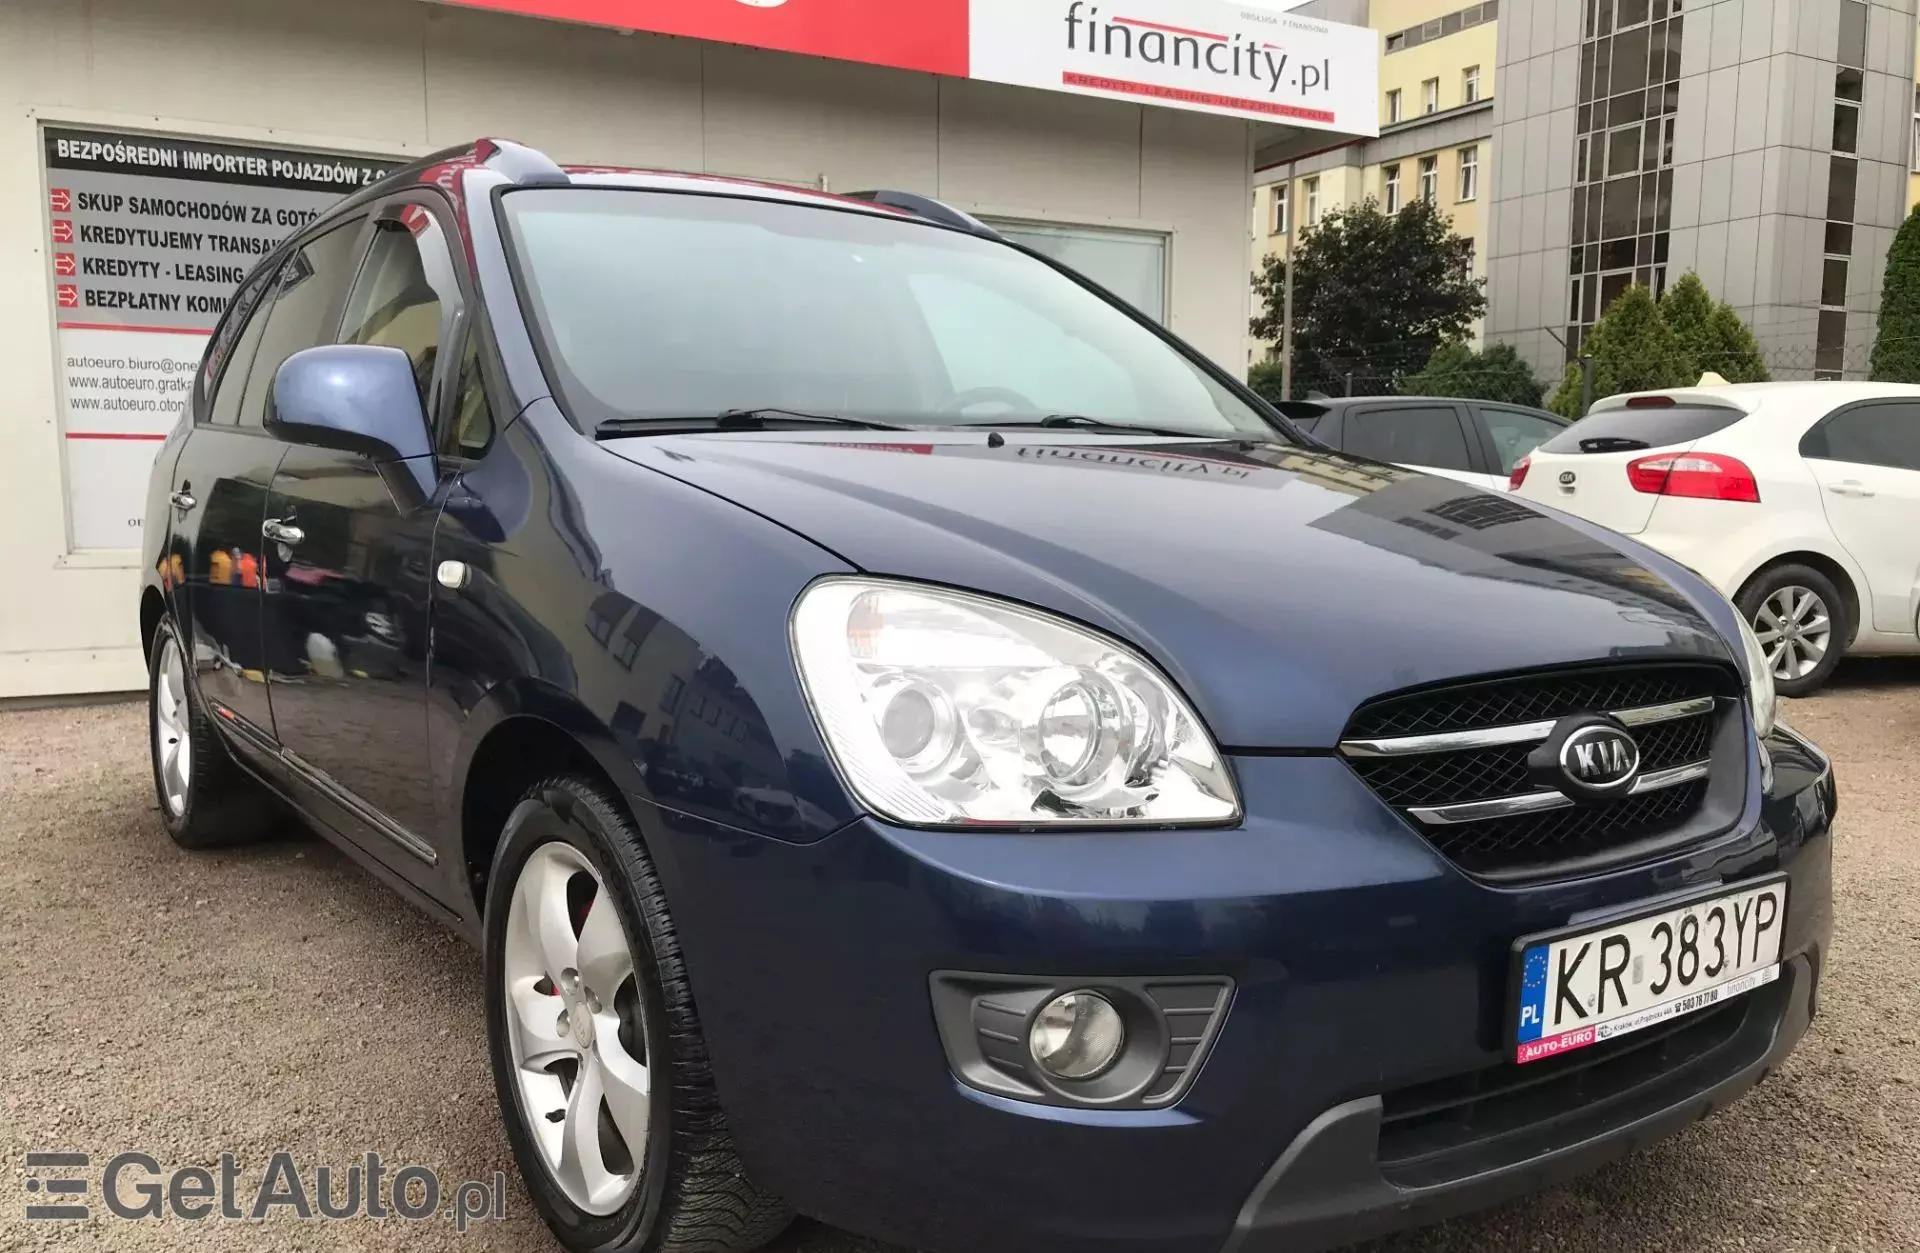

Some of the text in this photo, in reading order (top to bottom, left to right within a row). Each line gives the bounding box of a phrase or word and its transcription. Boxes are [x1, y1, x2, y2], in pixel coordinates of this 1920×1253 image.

[1064, 1, 1330, 96] financity.pl
[57, 139, 178, 169] BEZPOŚREDNI
[183, 151, 268, 177] IMPORTER
[271, 159, 358, 185] POJAZDÓW
[78, 192, 123, 213] SKUP
[129, 196, 247, 224] SAMOCHODÓW
[251, 207, 272, 225] ZA
[80, 225, 203, 251] KREDYTUJEMY
[82, 257, 160, 280] KREDYTY
[175, 264, 244, 284] LEASING
[85, 289, 181, 313] BEZPŁATNY
[1574, 738, 1631, 777] KIA
[1553, 891, 1778, 1025] KR 383YP
[1520, 1003, 1540, 1028] PL
[1526, 1031, 1593, 1058] AUTO-EURO
